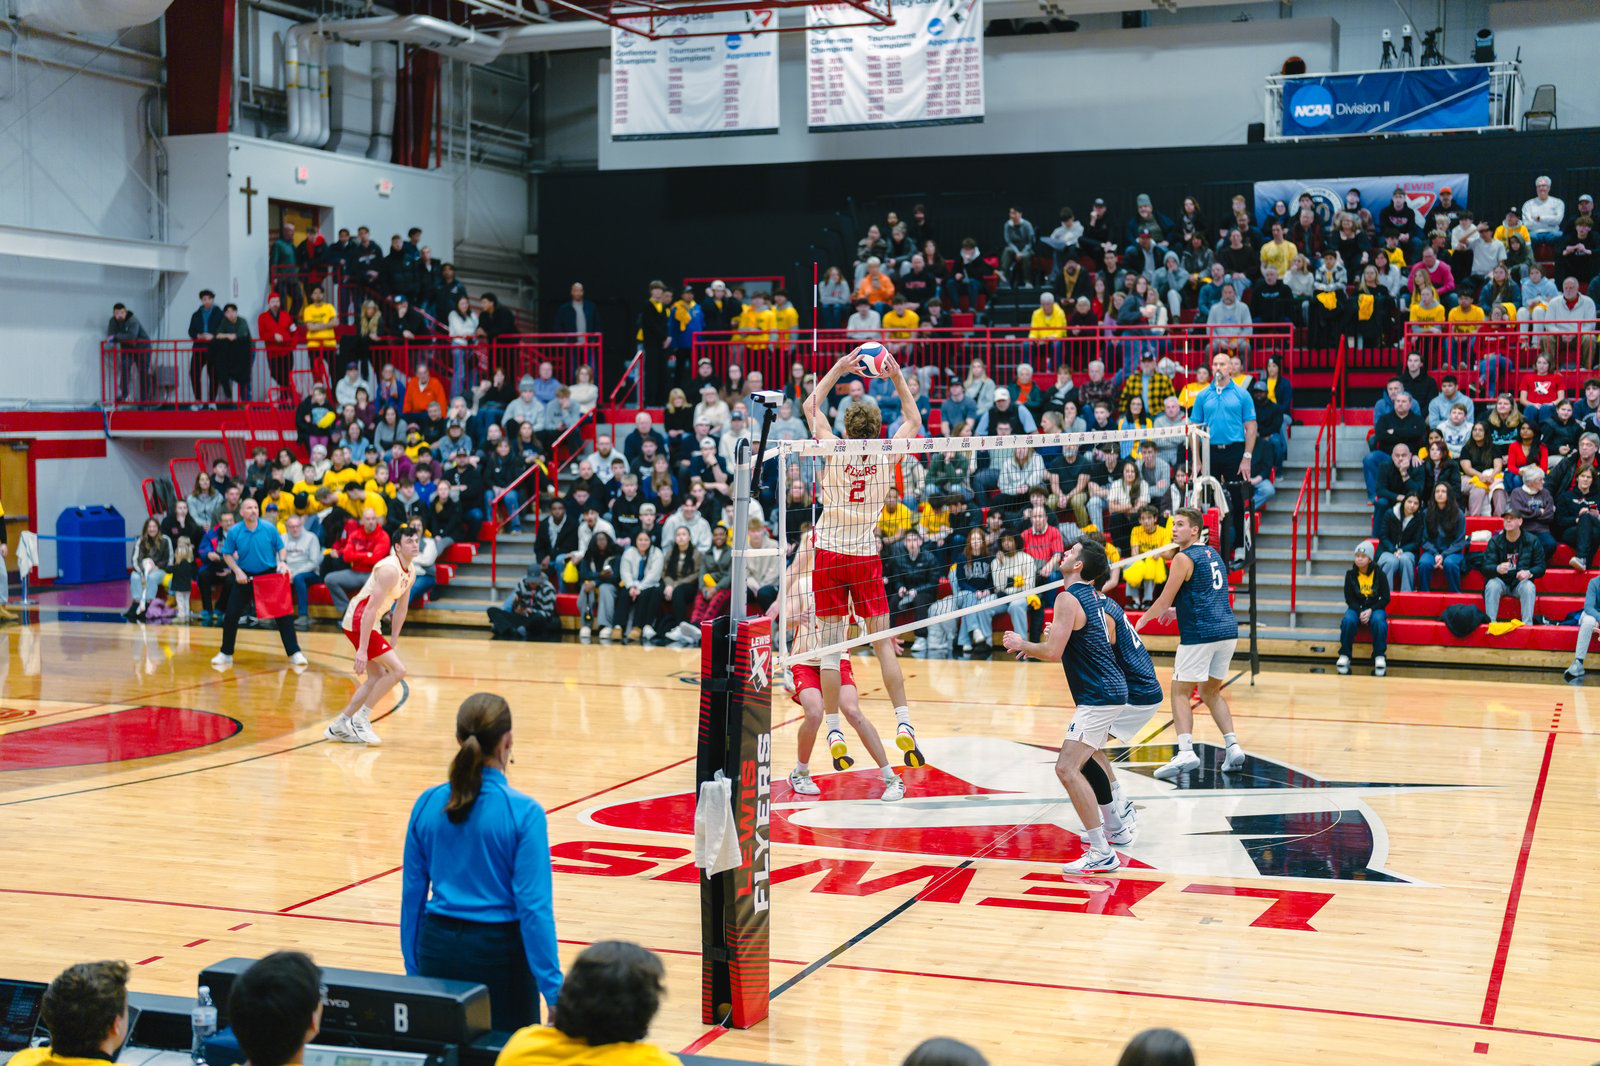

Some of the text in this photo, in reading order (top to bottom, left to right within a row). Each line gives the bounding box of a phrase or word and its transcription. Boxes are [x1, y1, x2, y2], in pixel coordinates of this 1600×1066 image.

[811, 37, 853, 46] Conference
[868, 33, 917, 42] Tournament
[669, 46, 715, 55] Tournament
[811, 46, 854, 54] Champions
[669, 55, 711, 63] Champions
[1294, 101, 1390, 117] NCAA Division II
[1396, 182, 1435, 191] LEWIS
[844, 464, 877, 477] FLYERS
[849, 479, 866, 503] 2
[1210, 561, 1224, 591] 5
[751, 637, 770, 646] LEWIS
[737, 759, 756, 899] LEWIS
[754, 733, 771, 915] FLYERS
[393, 1003, 409, 1033] B
